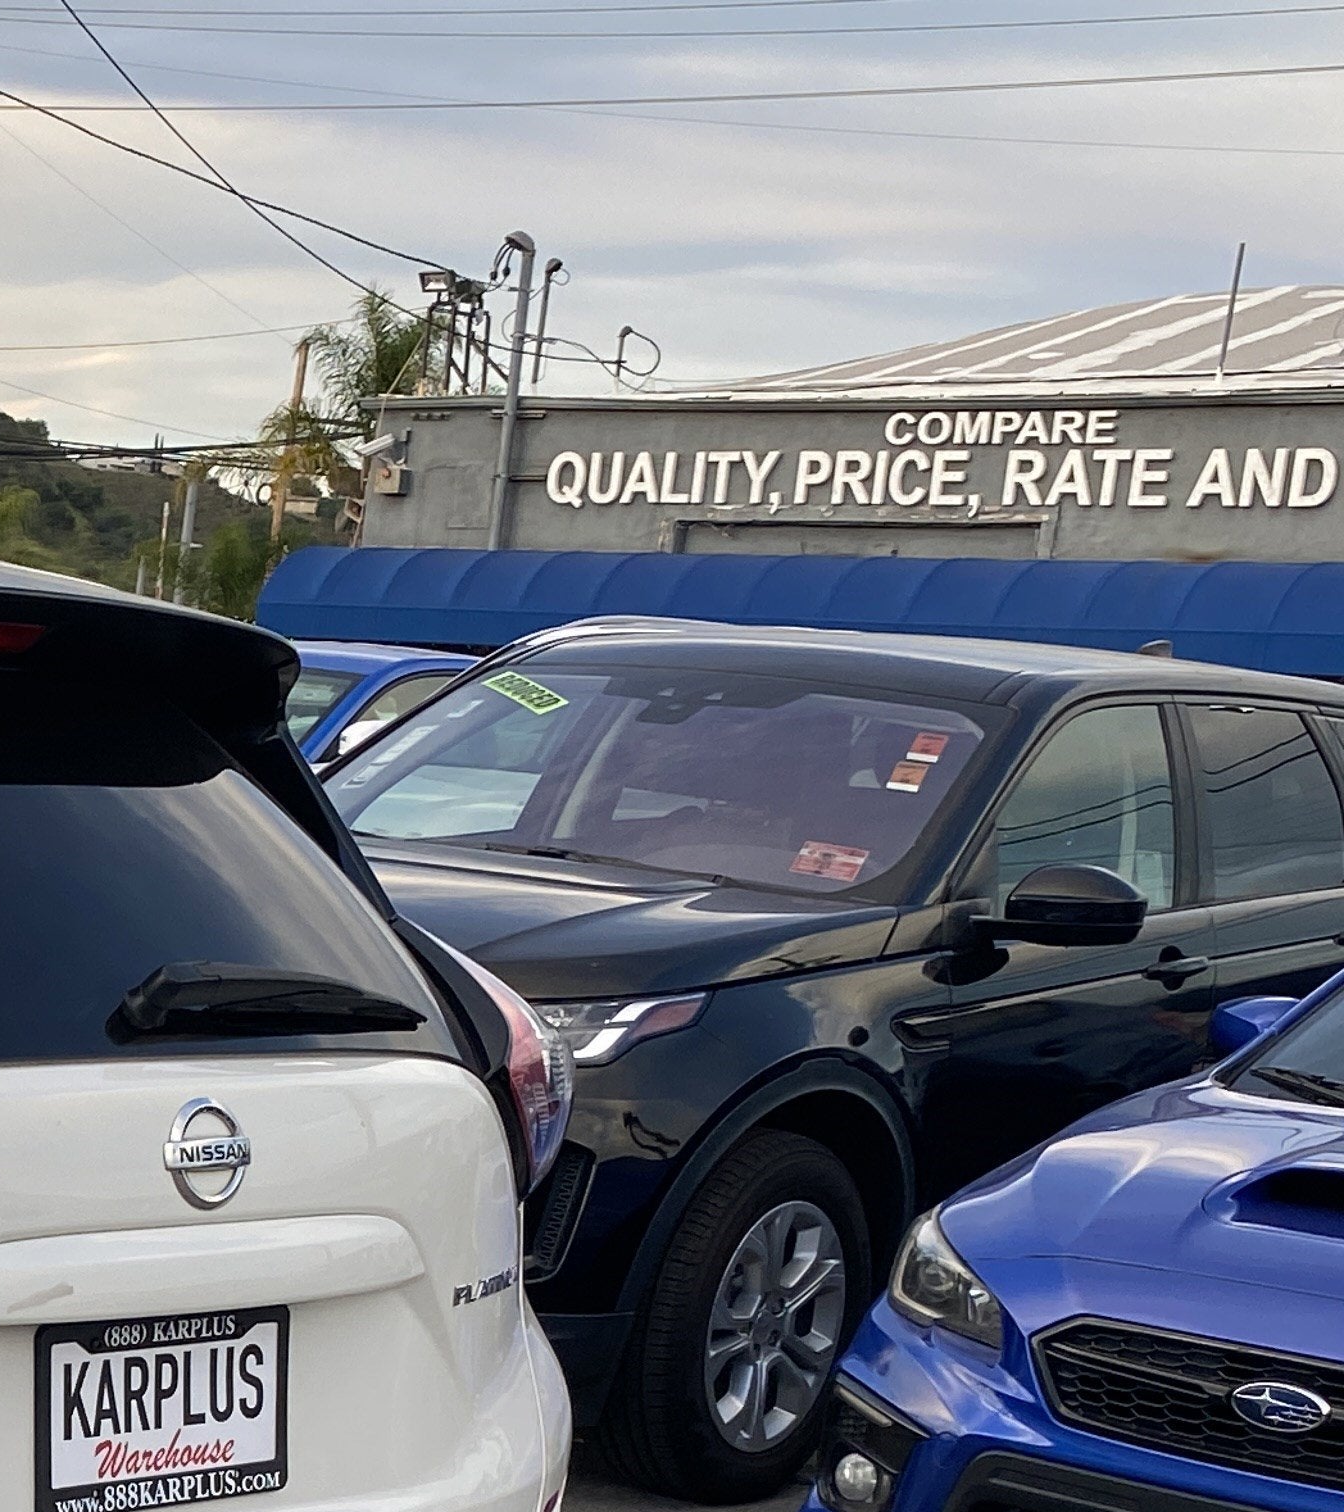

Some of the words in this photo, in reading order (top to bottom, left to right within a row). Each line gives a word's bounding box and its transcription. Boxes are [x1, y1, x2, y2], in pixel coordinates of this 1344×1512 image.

[885, 410, 1119, 445] COMPARE
[545, 450, 783, 515] QUALITY,
[793, 449, 982, 518] PRICE,
[1001, 448, 1174, 507] RATE
[1185, 447, 1340, 508] AND
[178, 1143, 248, 1164] NISSAN
[103, 1325, 148, 1348] (888)
[152, 1315, 236, 1343] KARPLUS
[63, 1343, 265, 1441] KARPLUS
[95, 1428, 235, 1479] Warehouse
